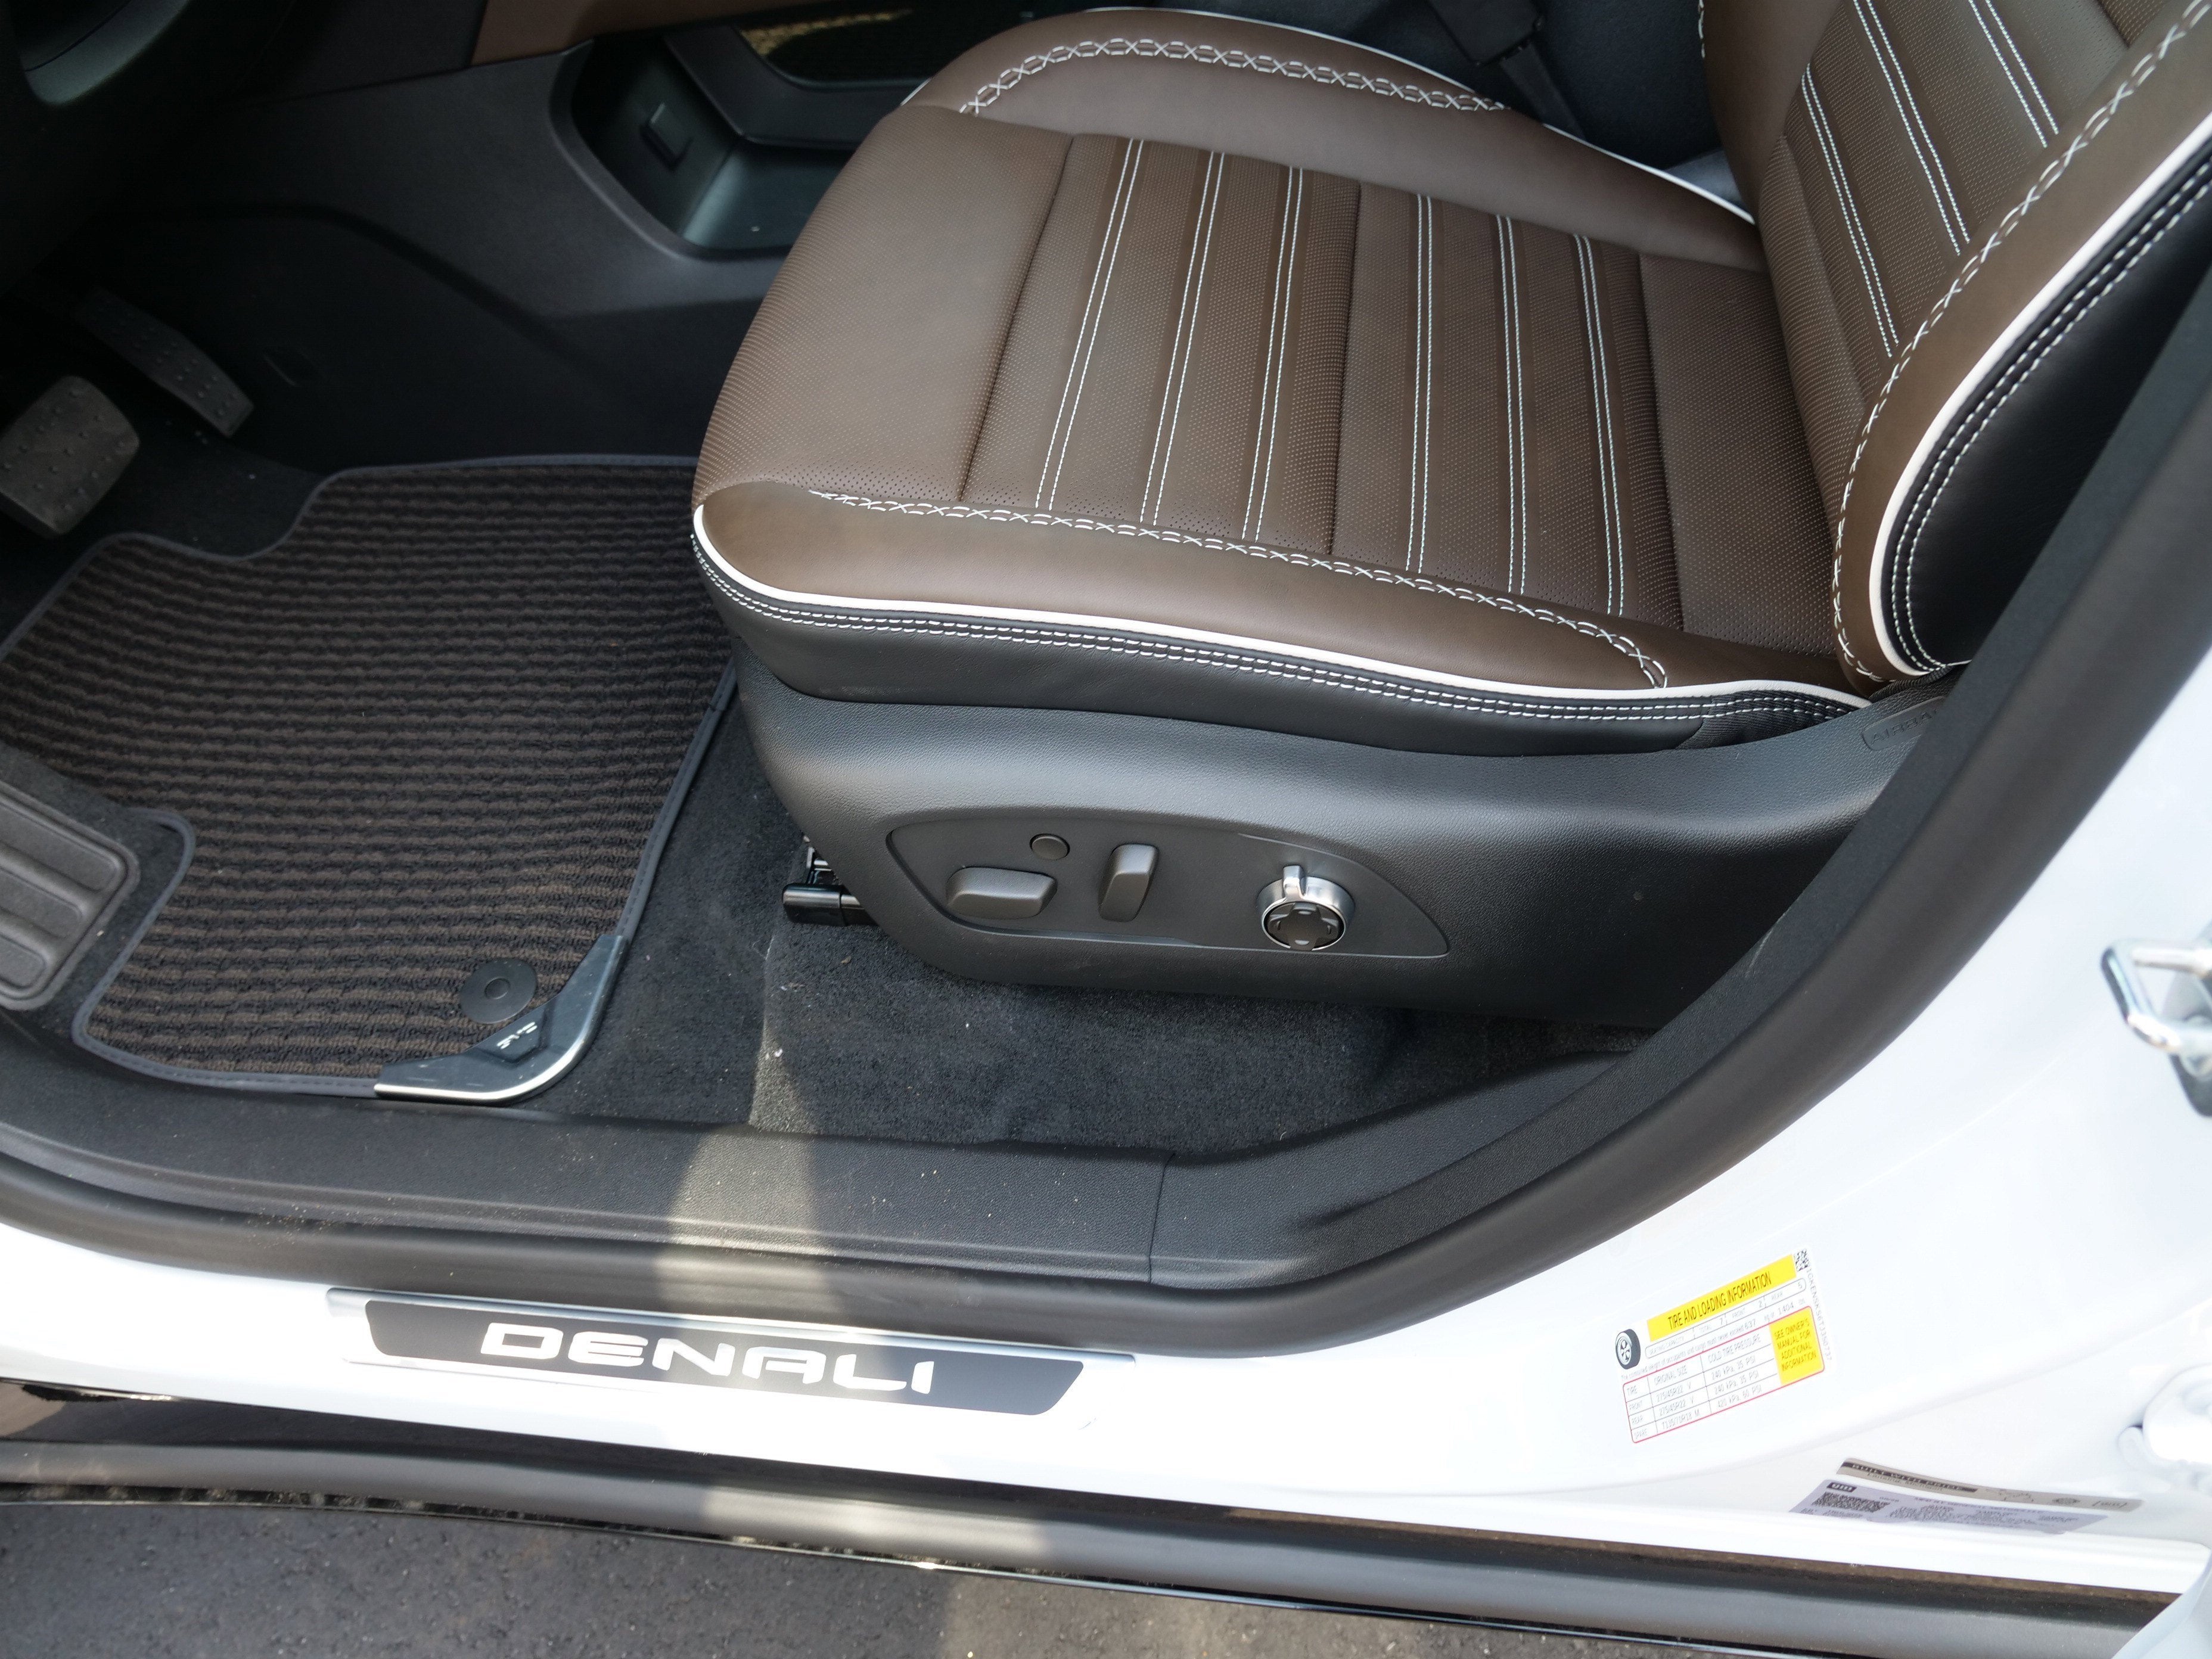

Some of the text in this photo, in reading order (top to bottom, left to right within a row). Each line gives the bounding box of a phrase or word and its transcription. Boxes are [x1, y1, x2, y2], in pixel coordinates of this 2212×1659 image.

[1871, 708, 1938, 745] AIRBA
[1667, 1271, 1772, 1330] TIRE AND LOADING INFORMATION
[1758, 1299, 1763, 1308] 2
[1777, 1301, 1794, 1315] 1404
[1774, 1318, 1810, 1340] SEE OWNER'S
[1776, 1328, 1810, 1350] MANUAL FOR
[480, 1322, 935, 1394] DENALI
[1707, 1350, 1722, 1363] COLD
[1733, 1333, 1760, 1352] PRESSURE
[1781, 1340, 1812, 1360] ADDITIONAL
[1745, 1354, 1756, 1366] PSI
[1781, 1350, 1816, 1371] INFORMATION
[1748, 1369, 1759, 1380] PSI
[1751, 1383, 1762, 1395] PSI
